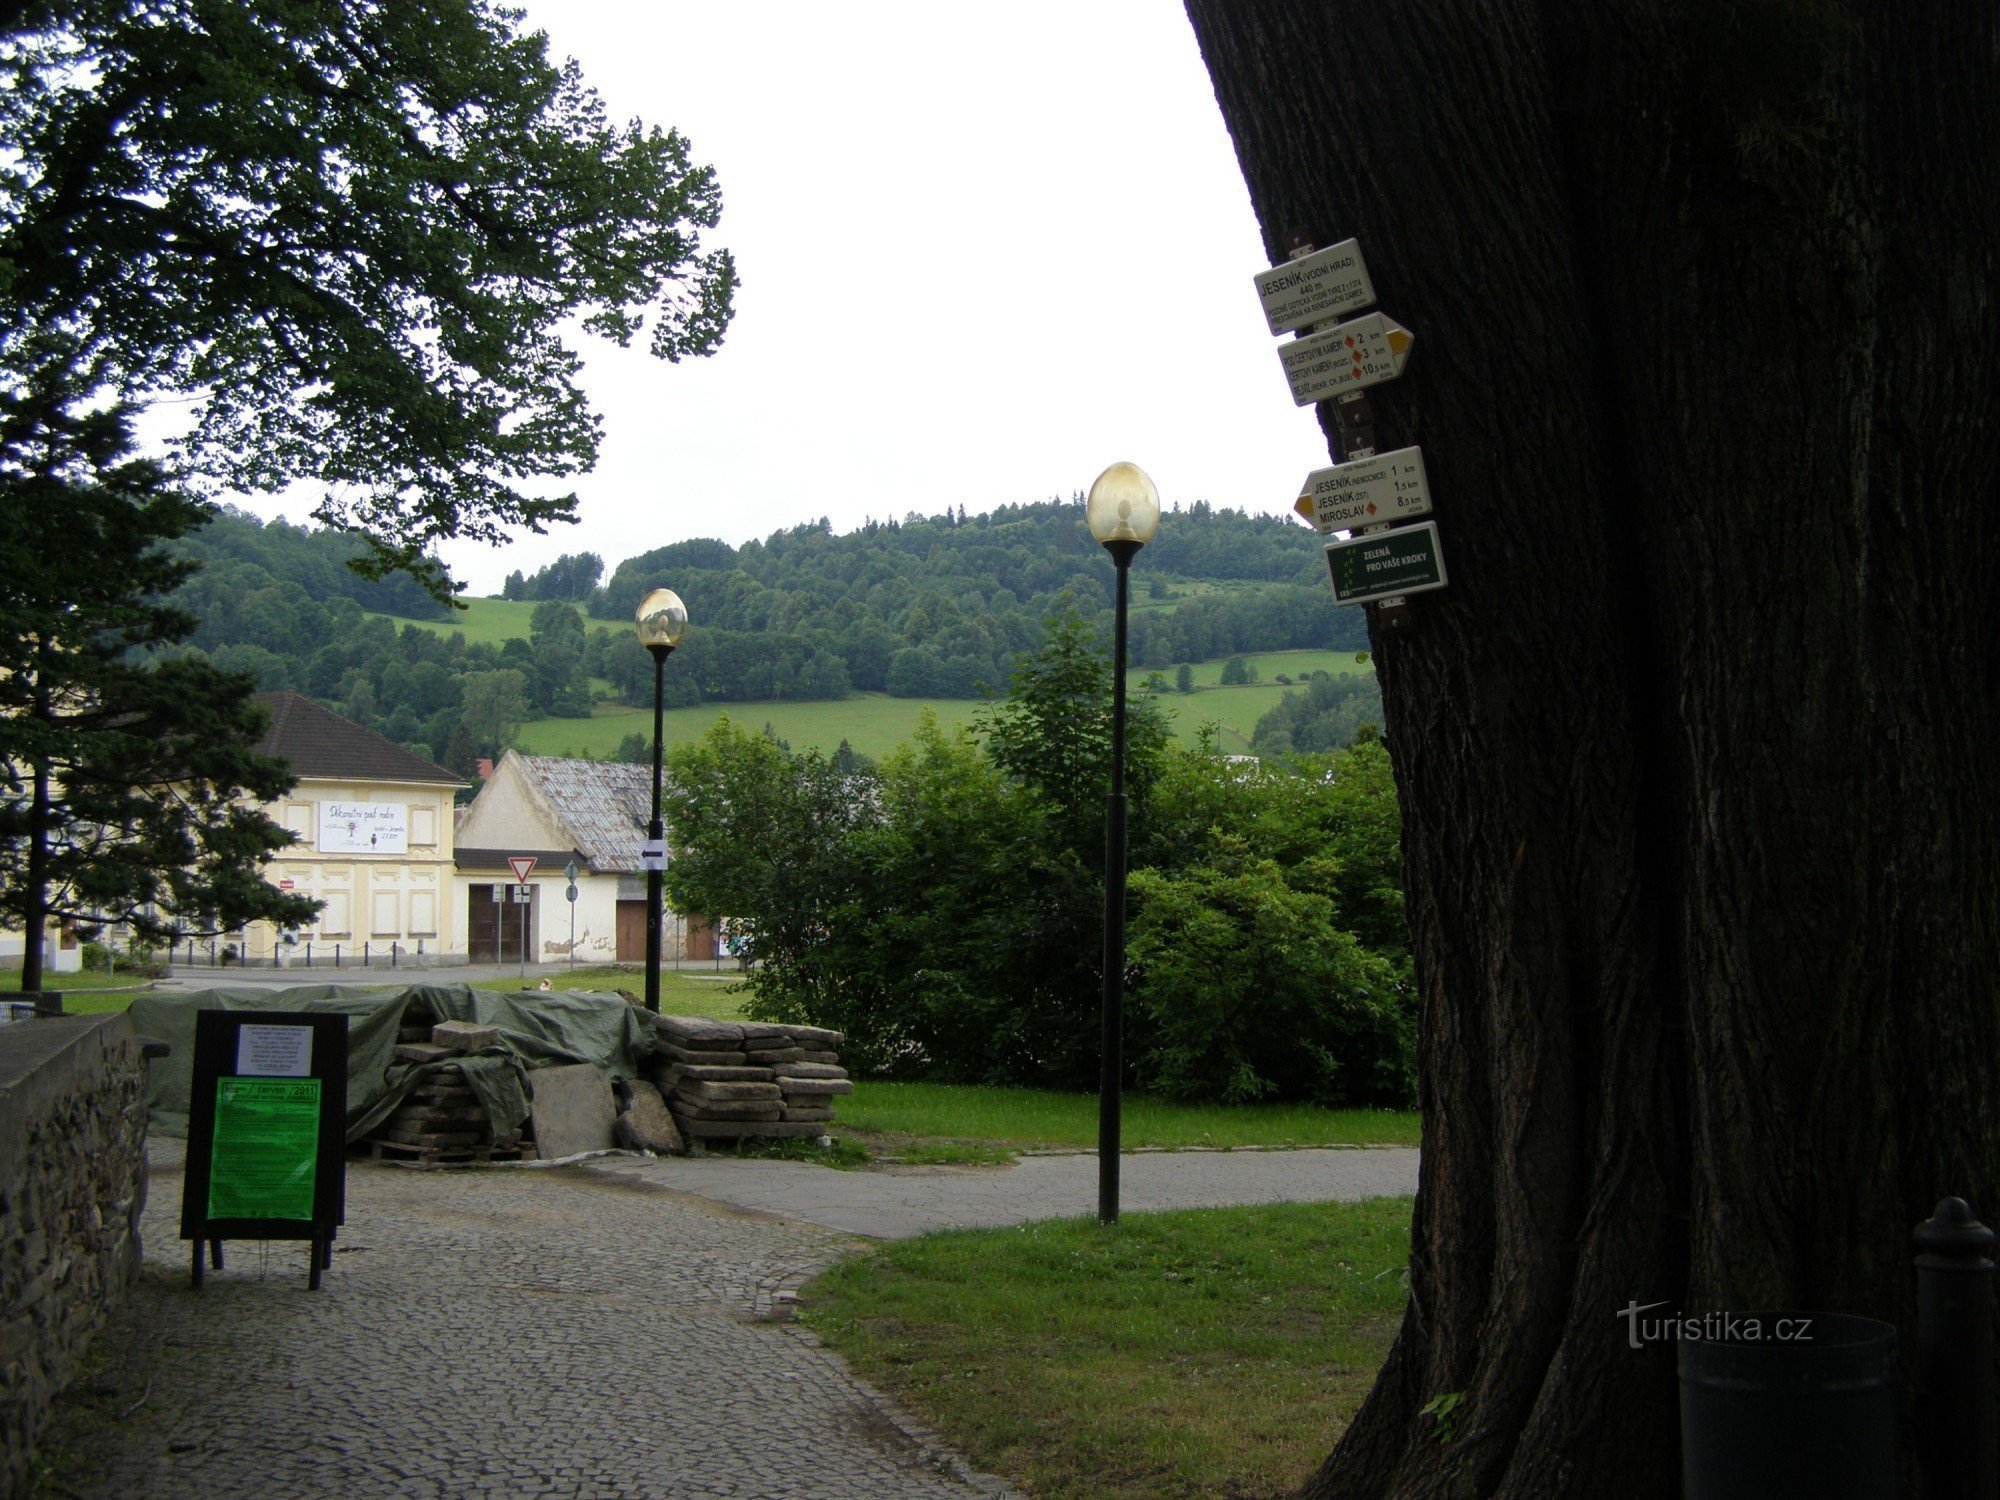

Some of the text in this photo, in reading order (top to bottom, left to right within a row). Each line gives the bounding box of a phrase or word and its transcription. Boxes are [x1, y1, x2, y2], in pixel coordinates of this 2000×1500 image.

[1260, 271, 1304, 297] JESENÍK
[1329, 256, 1355, 272] HRAD)
[1299, 282, 1323, 296] 440 m
[1356, 333, 1365, 344] 2
[1369, 331, 1381, 340] km
[1362, 348, 1370, 359] 3
[1375, 346, 1385, 355] km
[1380, 362, 1391, 370] km
[1314, 476, 1351, 494] JESENÍK
[1391, 465, 1397, 476] 1
[1317, 491, 1354, 509] JESENÍK
[1320, 504, 1366, 524] MIROSLAV
[1364, 546, 1391, 560] ZELENÁ
[1366, 553, 1427, 572] PRO VAŠE KROKY
[294, 1087, 314, 1095] 2011
